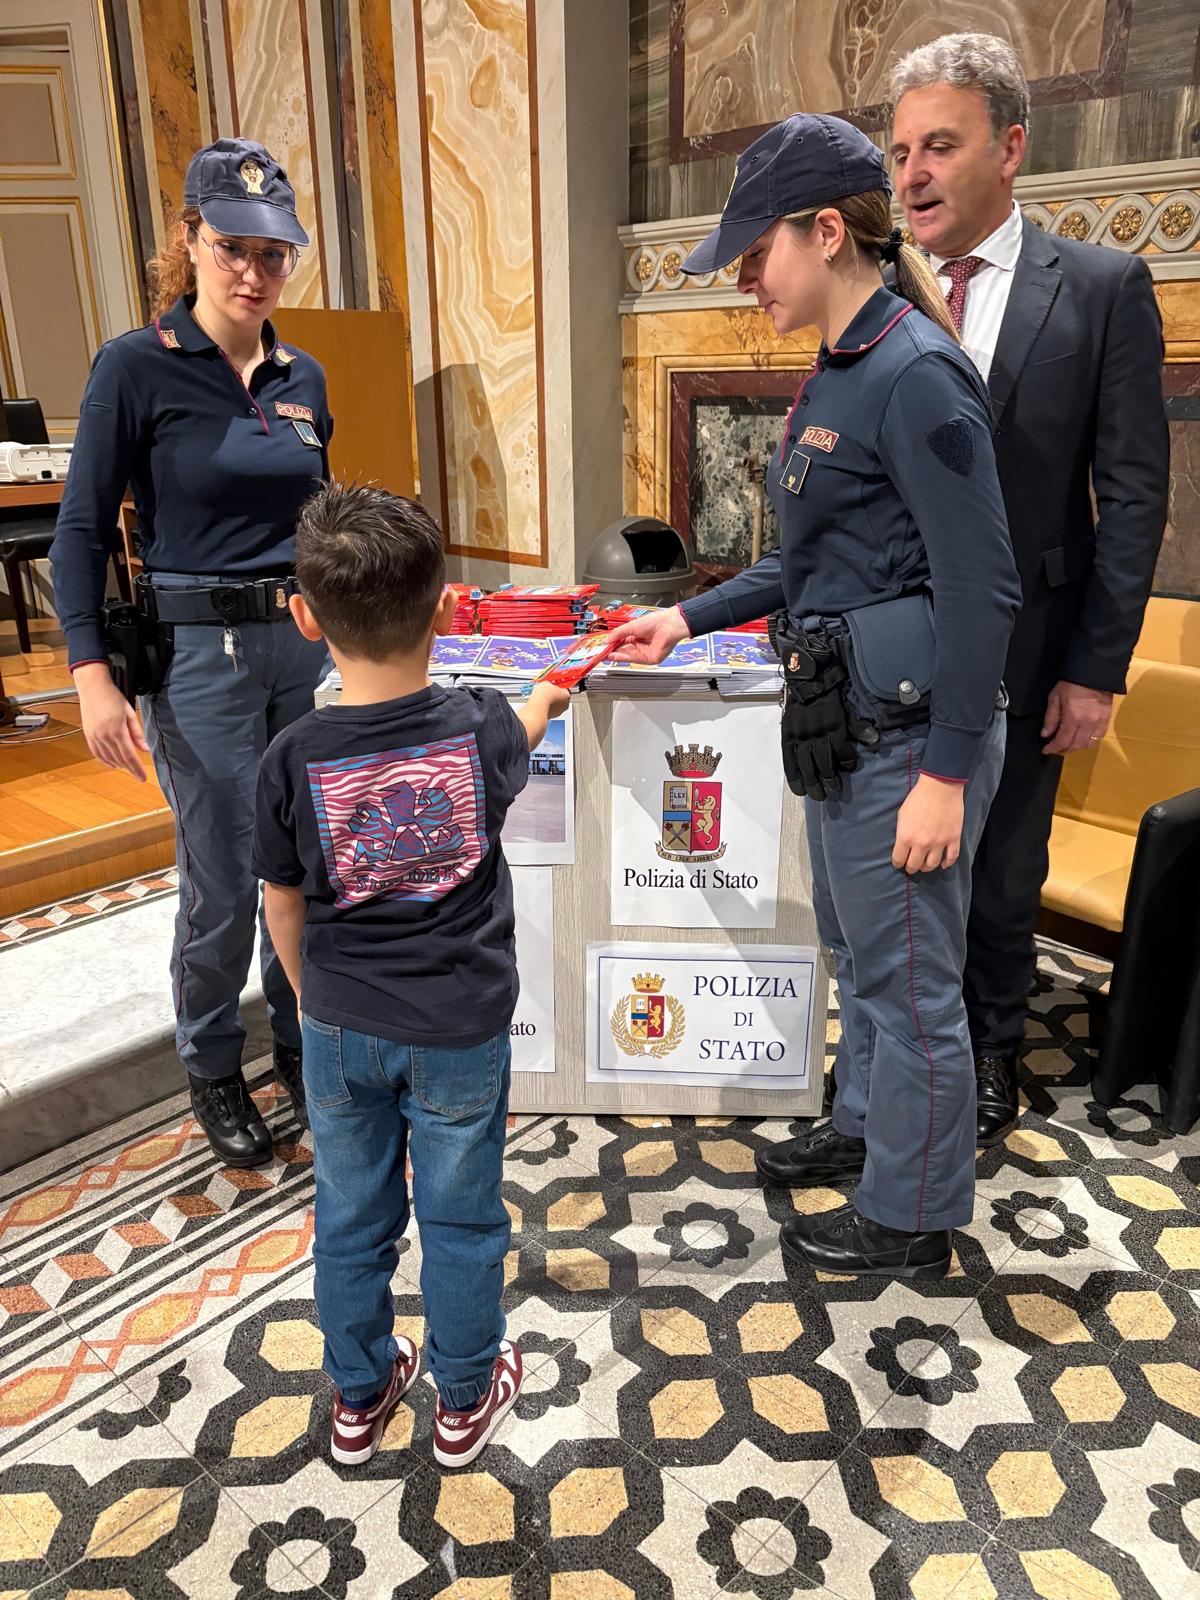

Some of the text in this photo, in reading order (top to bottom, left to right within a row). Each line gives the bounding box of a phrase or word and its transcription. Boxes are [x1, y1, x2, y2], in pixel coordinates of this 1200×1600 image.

[624, 868, 759, 890] Polizia di Stato
[693, 975, 799, 998] POLIZIA
[734, 1012, 754, 1027] DI
[510, 1020, 537, 1036] ato
[698, 1038, 786, 1062] STATO
[339, 1411, 359, 1423] NIKE
[441, 1416, 462, 1426] NIKE
